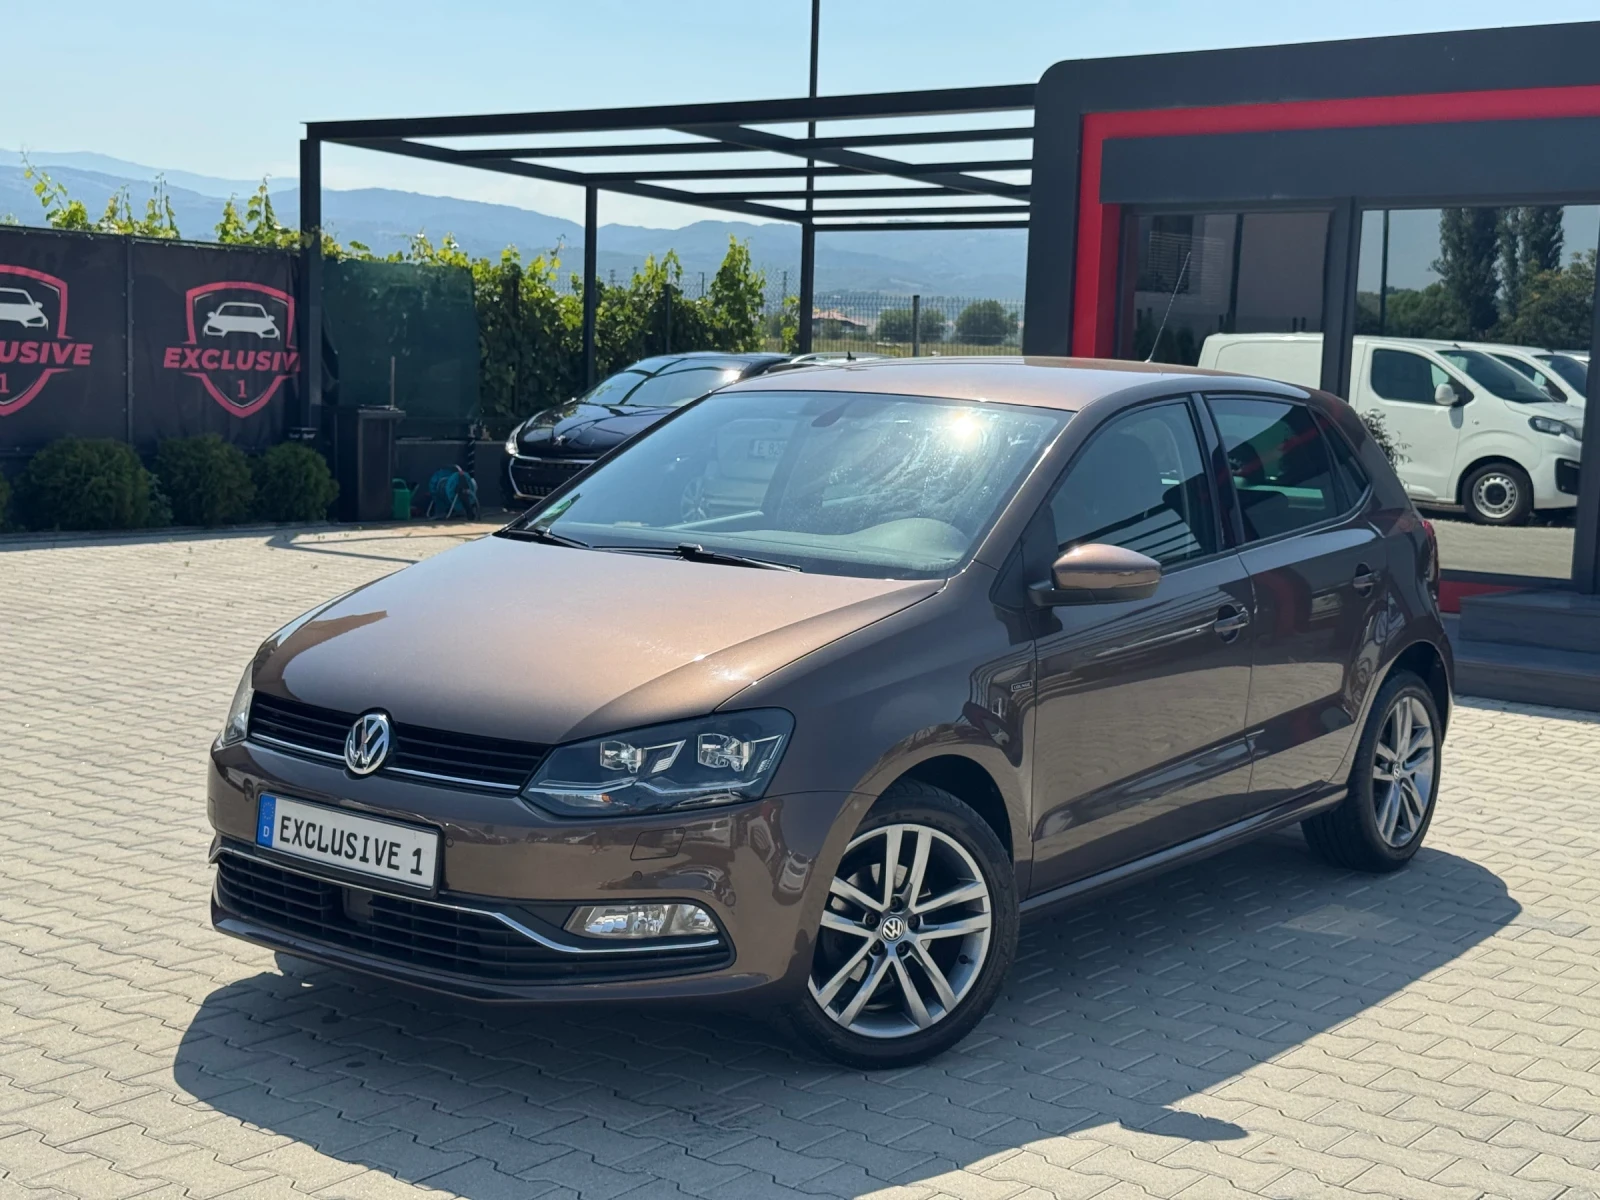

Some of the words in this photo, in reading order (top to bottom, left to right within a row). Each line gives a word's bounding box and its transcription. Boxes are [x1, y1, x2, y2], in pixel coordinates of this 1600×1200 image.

[163, 347, 300, 372] EXCLUSIV
[237, 379, 248, 398] 1
[263, 826, 270, 838] D
[279, 815, 402, 871] EXCLUSIVE
[410, 847, 423, 876] 1
[882, 917, 904, 940] VW
